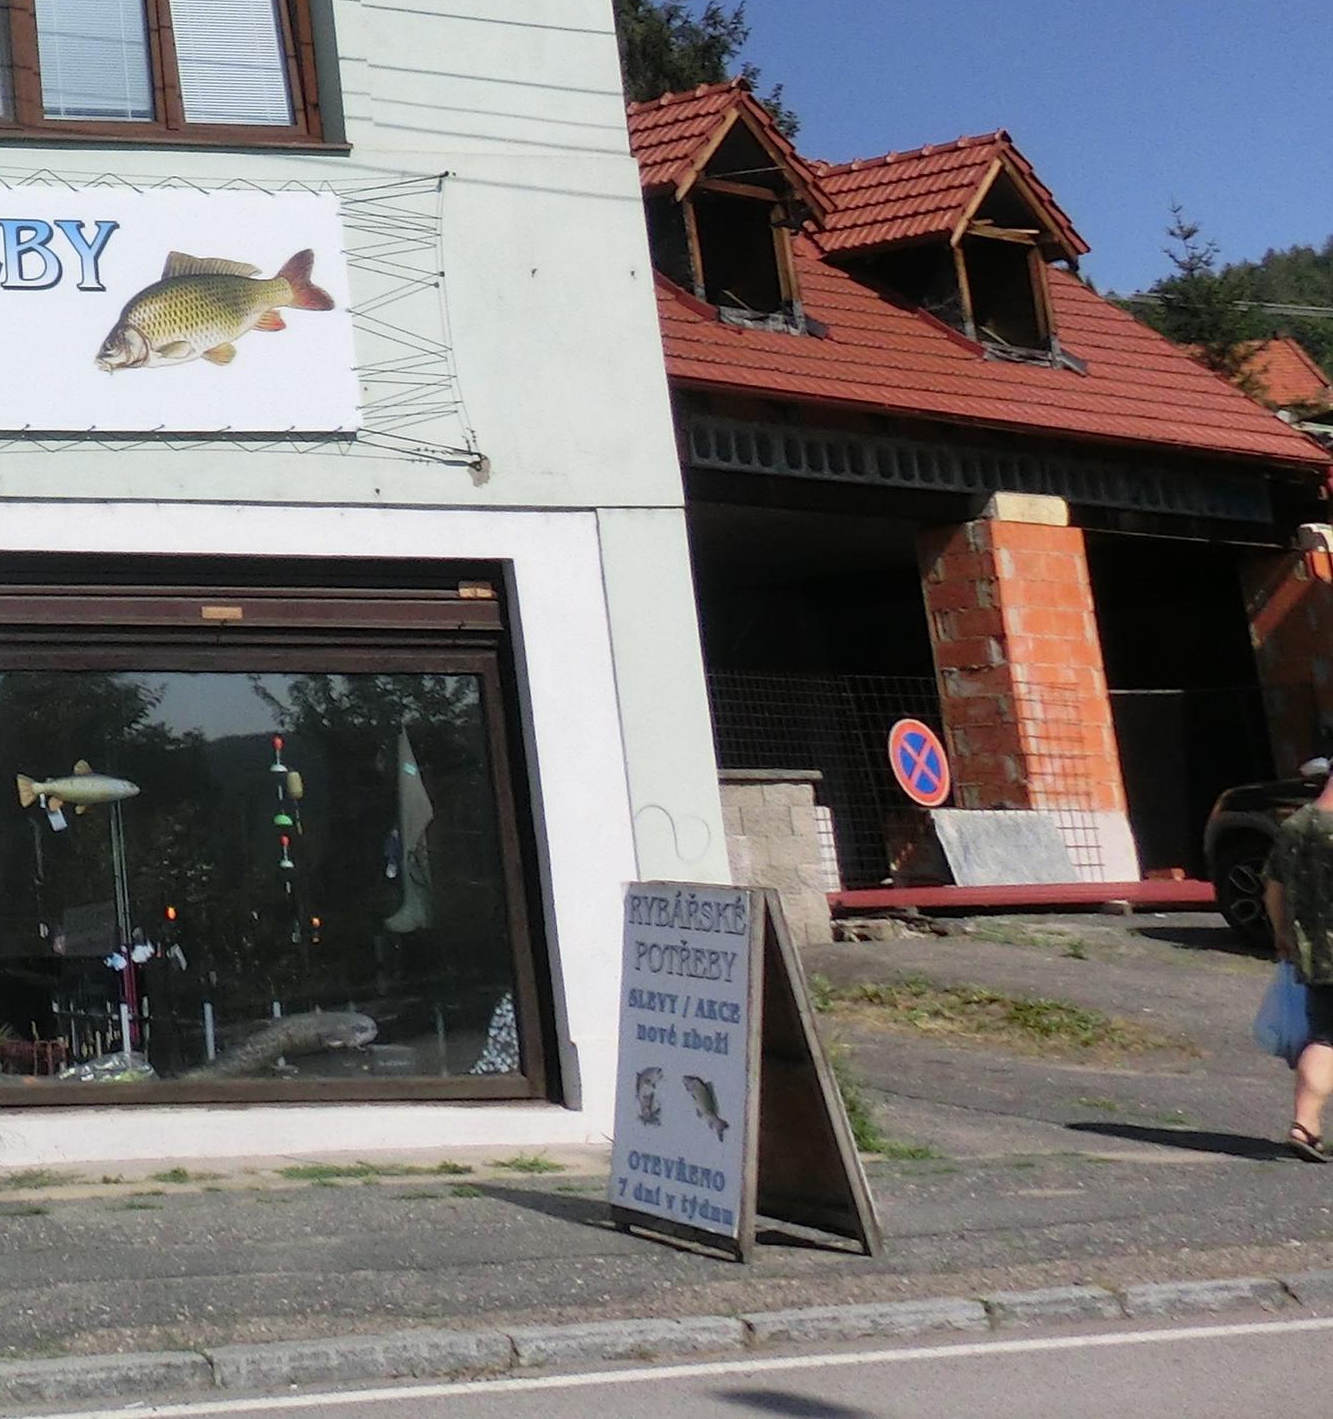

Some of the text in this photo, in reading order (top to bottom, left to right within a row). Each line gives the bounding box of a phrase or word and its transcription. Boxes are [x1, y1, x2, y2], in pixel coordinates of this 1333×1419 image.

[629, 891, 747, 936] RYBÁŘSKÉ
[634, 939, 738, 982] POTŘEBY
[628, 988, 678, 1014] SLEVY
[695, 998, 741, 1024] AKCE
[636, 1023, 729, 1055] nové zboží
[628, 1150, 725, 1192] OTEVŘENO
[618, 1177, 733, 1226] 7 dní v týdnu
